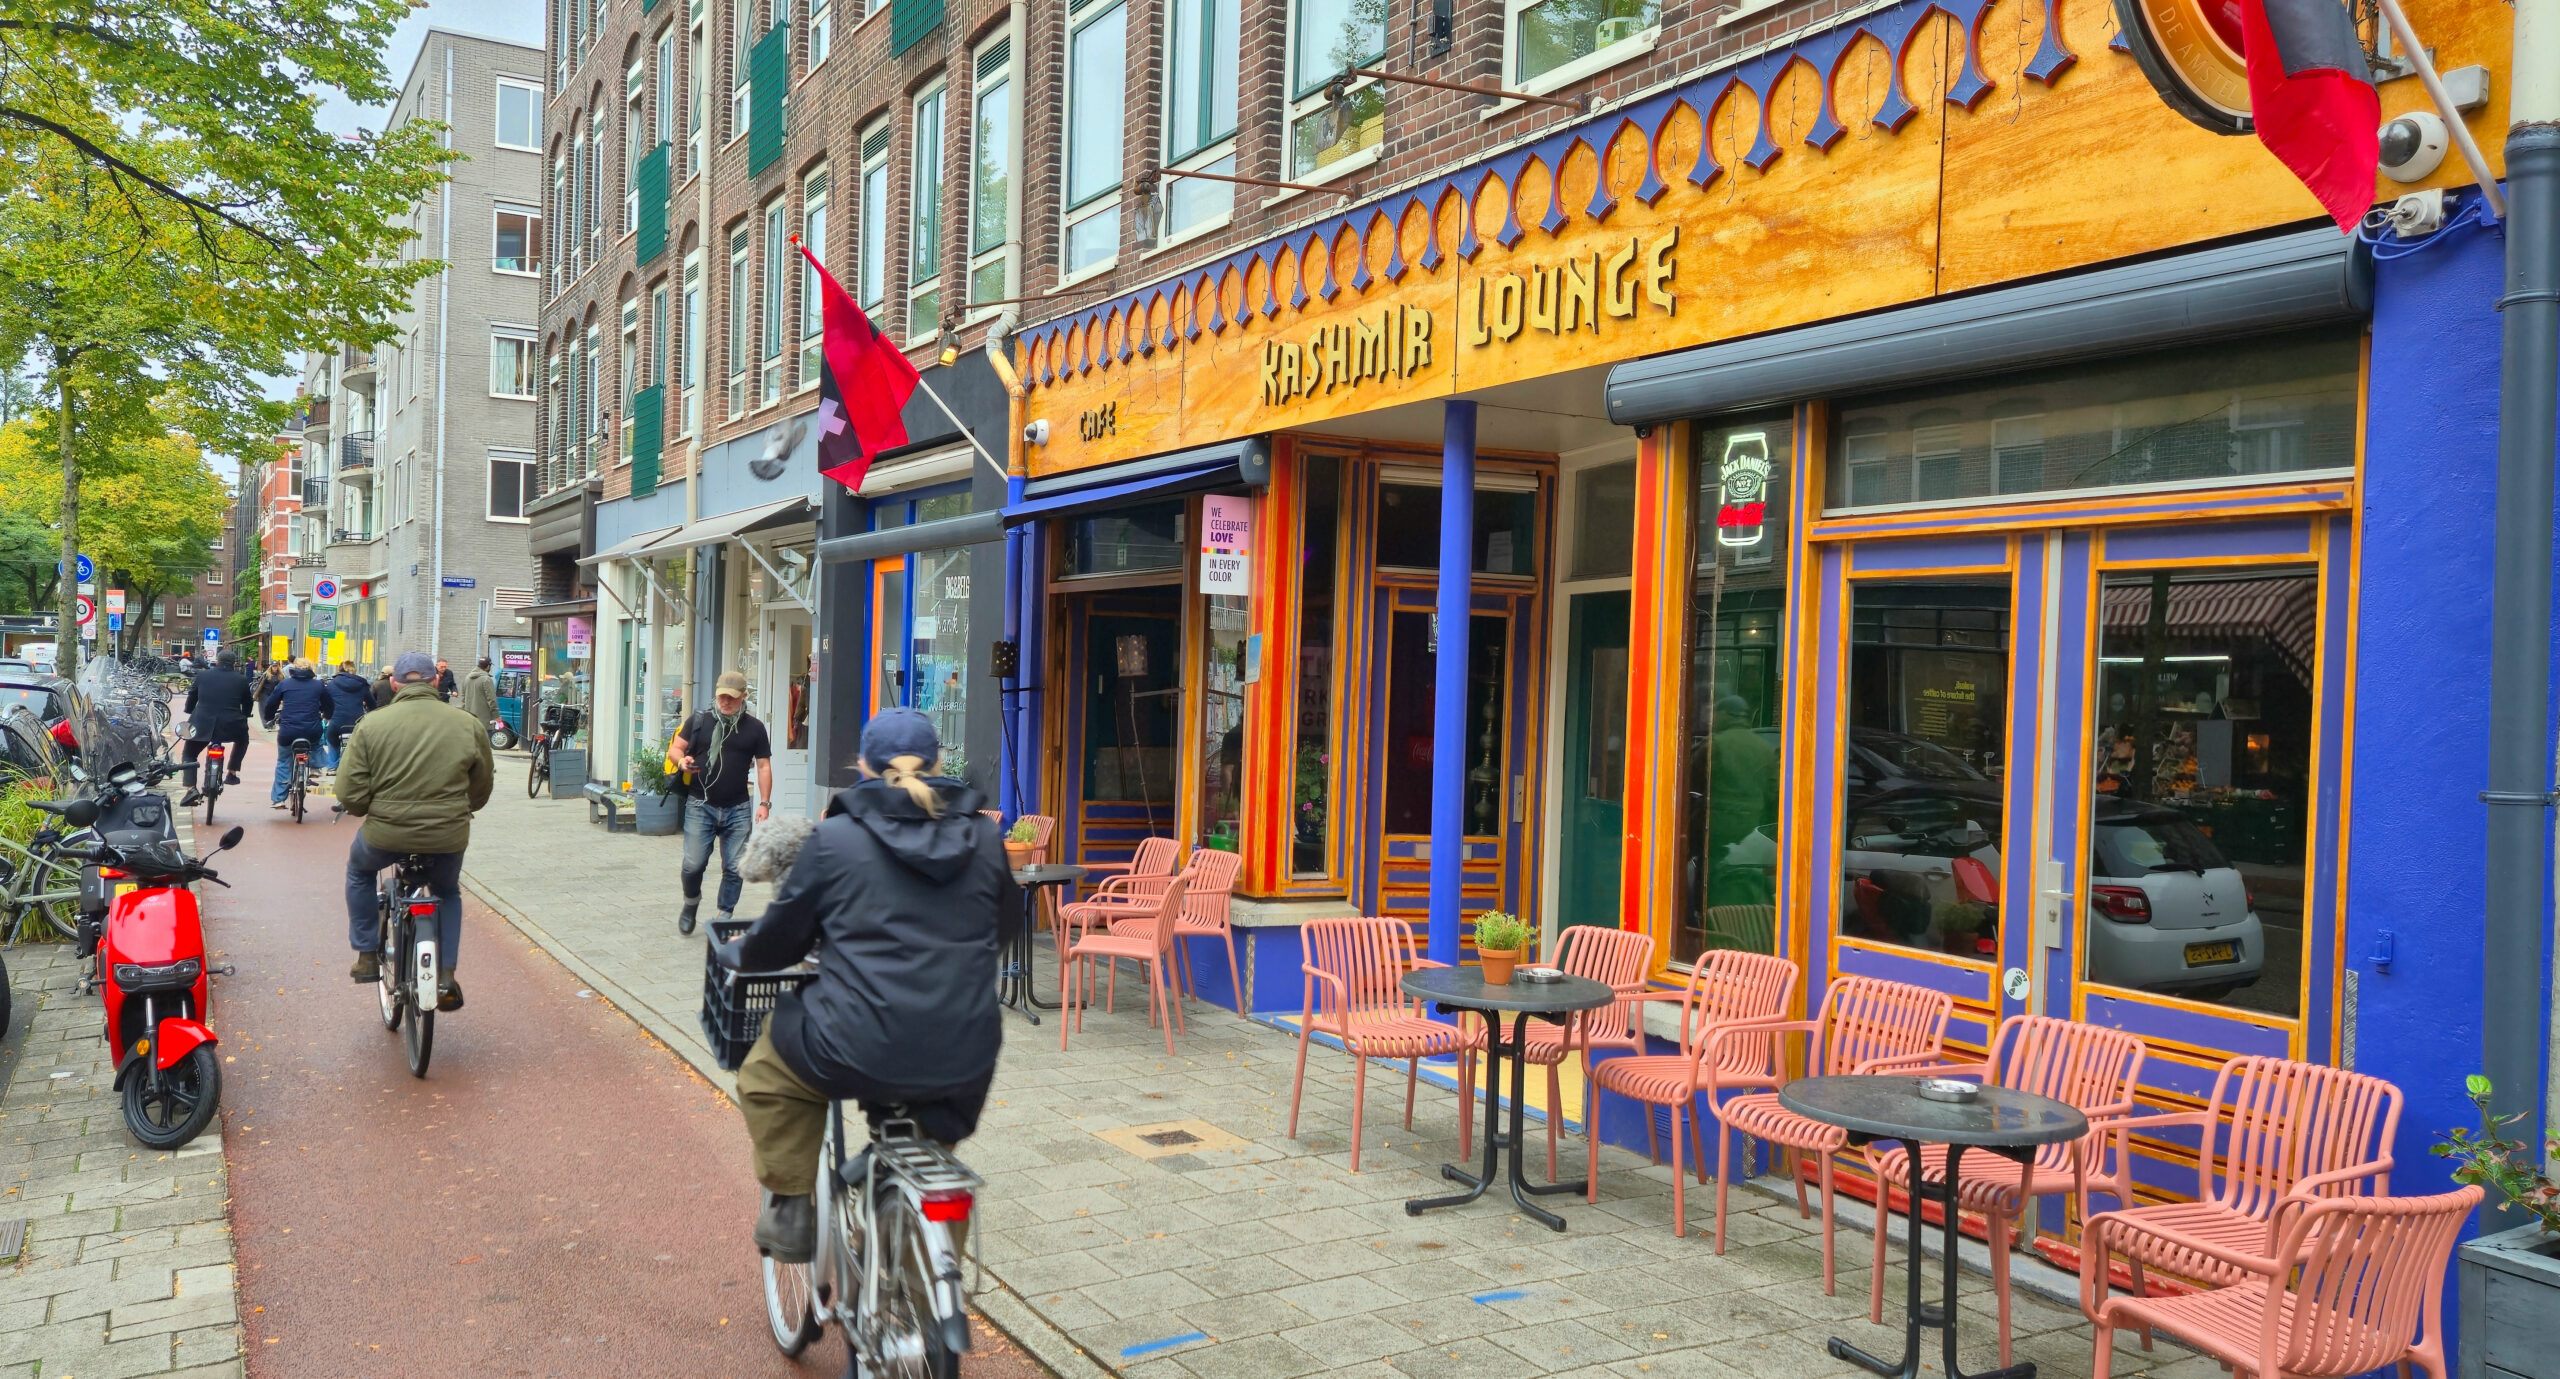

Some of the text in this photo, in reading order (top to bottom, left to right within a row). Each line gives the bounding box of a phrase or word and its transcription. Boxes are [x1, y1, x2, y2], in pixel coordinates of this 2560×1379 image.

[2158, 6, 2240, 102] DE AMSTEL
[1260, 226, 1680, 406] KASHMIR LOUNGE
[1079, 401, 1116, 442] CAFE
[1721, 458, 1741, 481] JACK
[1211, 507, 1222, 518] WE
[1210, 519, 1248, 532] CELEBRATE
[1210, 532, 1234, 543] LOVE
[1209, 558, 1241, 570] IN EVERY
[1209, 571, 1232, 582] COLOR
